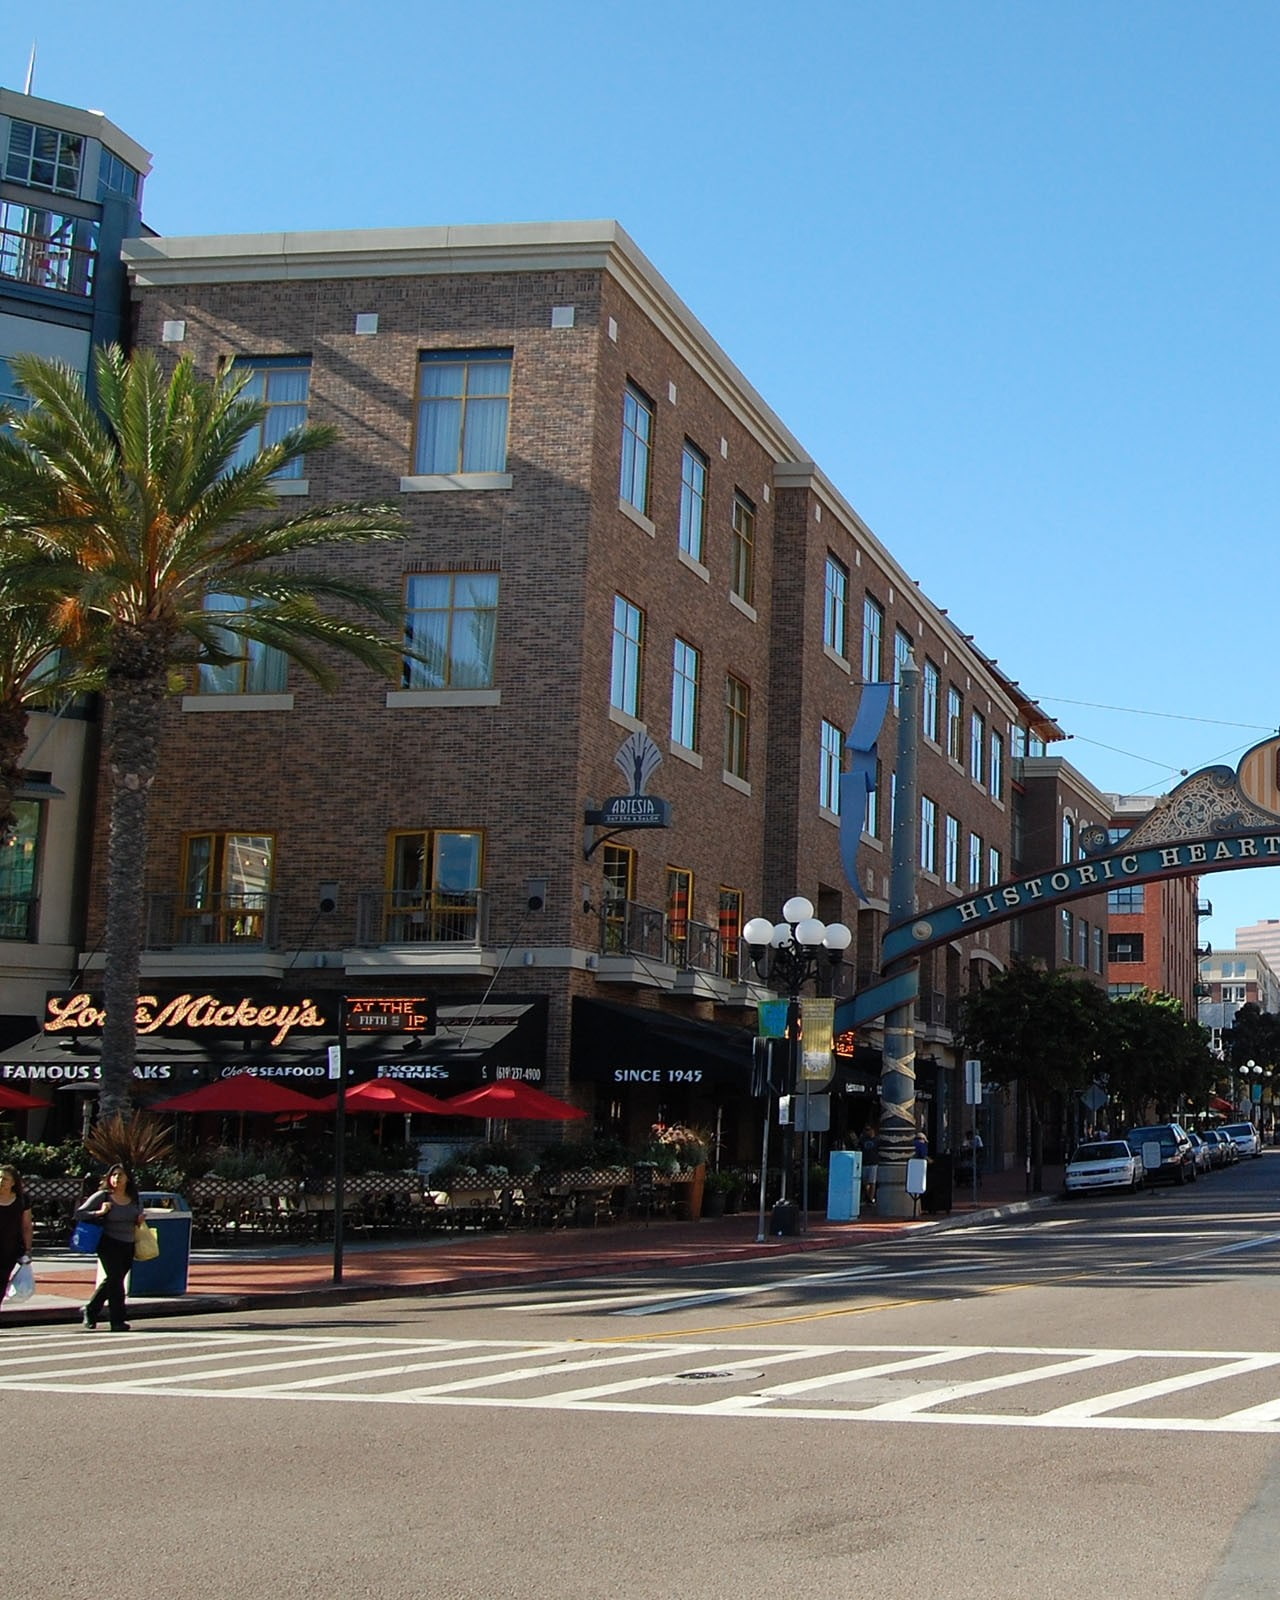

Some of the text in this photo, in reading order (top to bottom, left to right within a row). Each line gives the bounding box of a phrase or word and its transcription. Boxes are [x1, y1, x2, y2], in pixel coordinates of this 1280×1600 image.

[611, 799, 654, 814] ARTESIA
[957, 854, 1138, 922] HISTORIC
[1159, 836, 1280, 868] HEART
[353, 1002, 413, 1014] AT THE
[136, 994, 325, 1046] Mickey's
[359, 1015, 387, 1025] FIFTH
[3, 1065, 90, 1079] FAMOUS
[94, 1065, 171, 1079] SAKS
[259, 1066, 325, 1077] SEAFOOD
[614, 1069, 703, 1082] SINCE 1945
